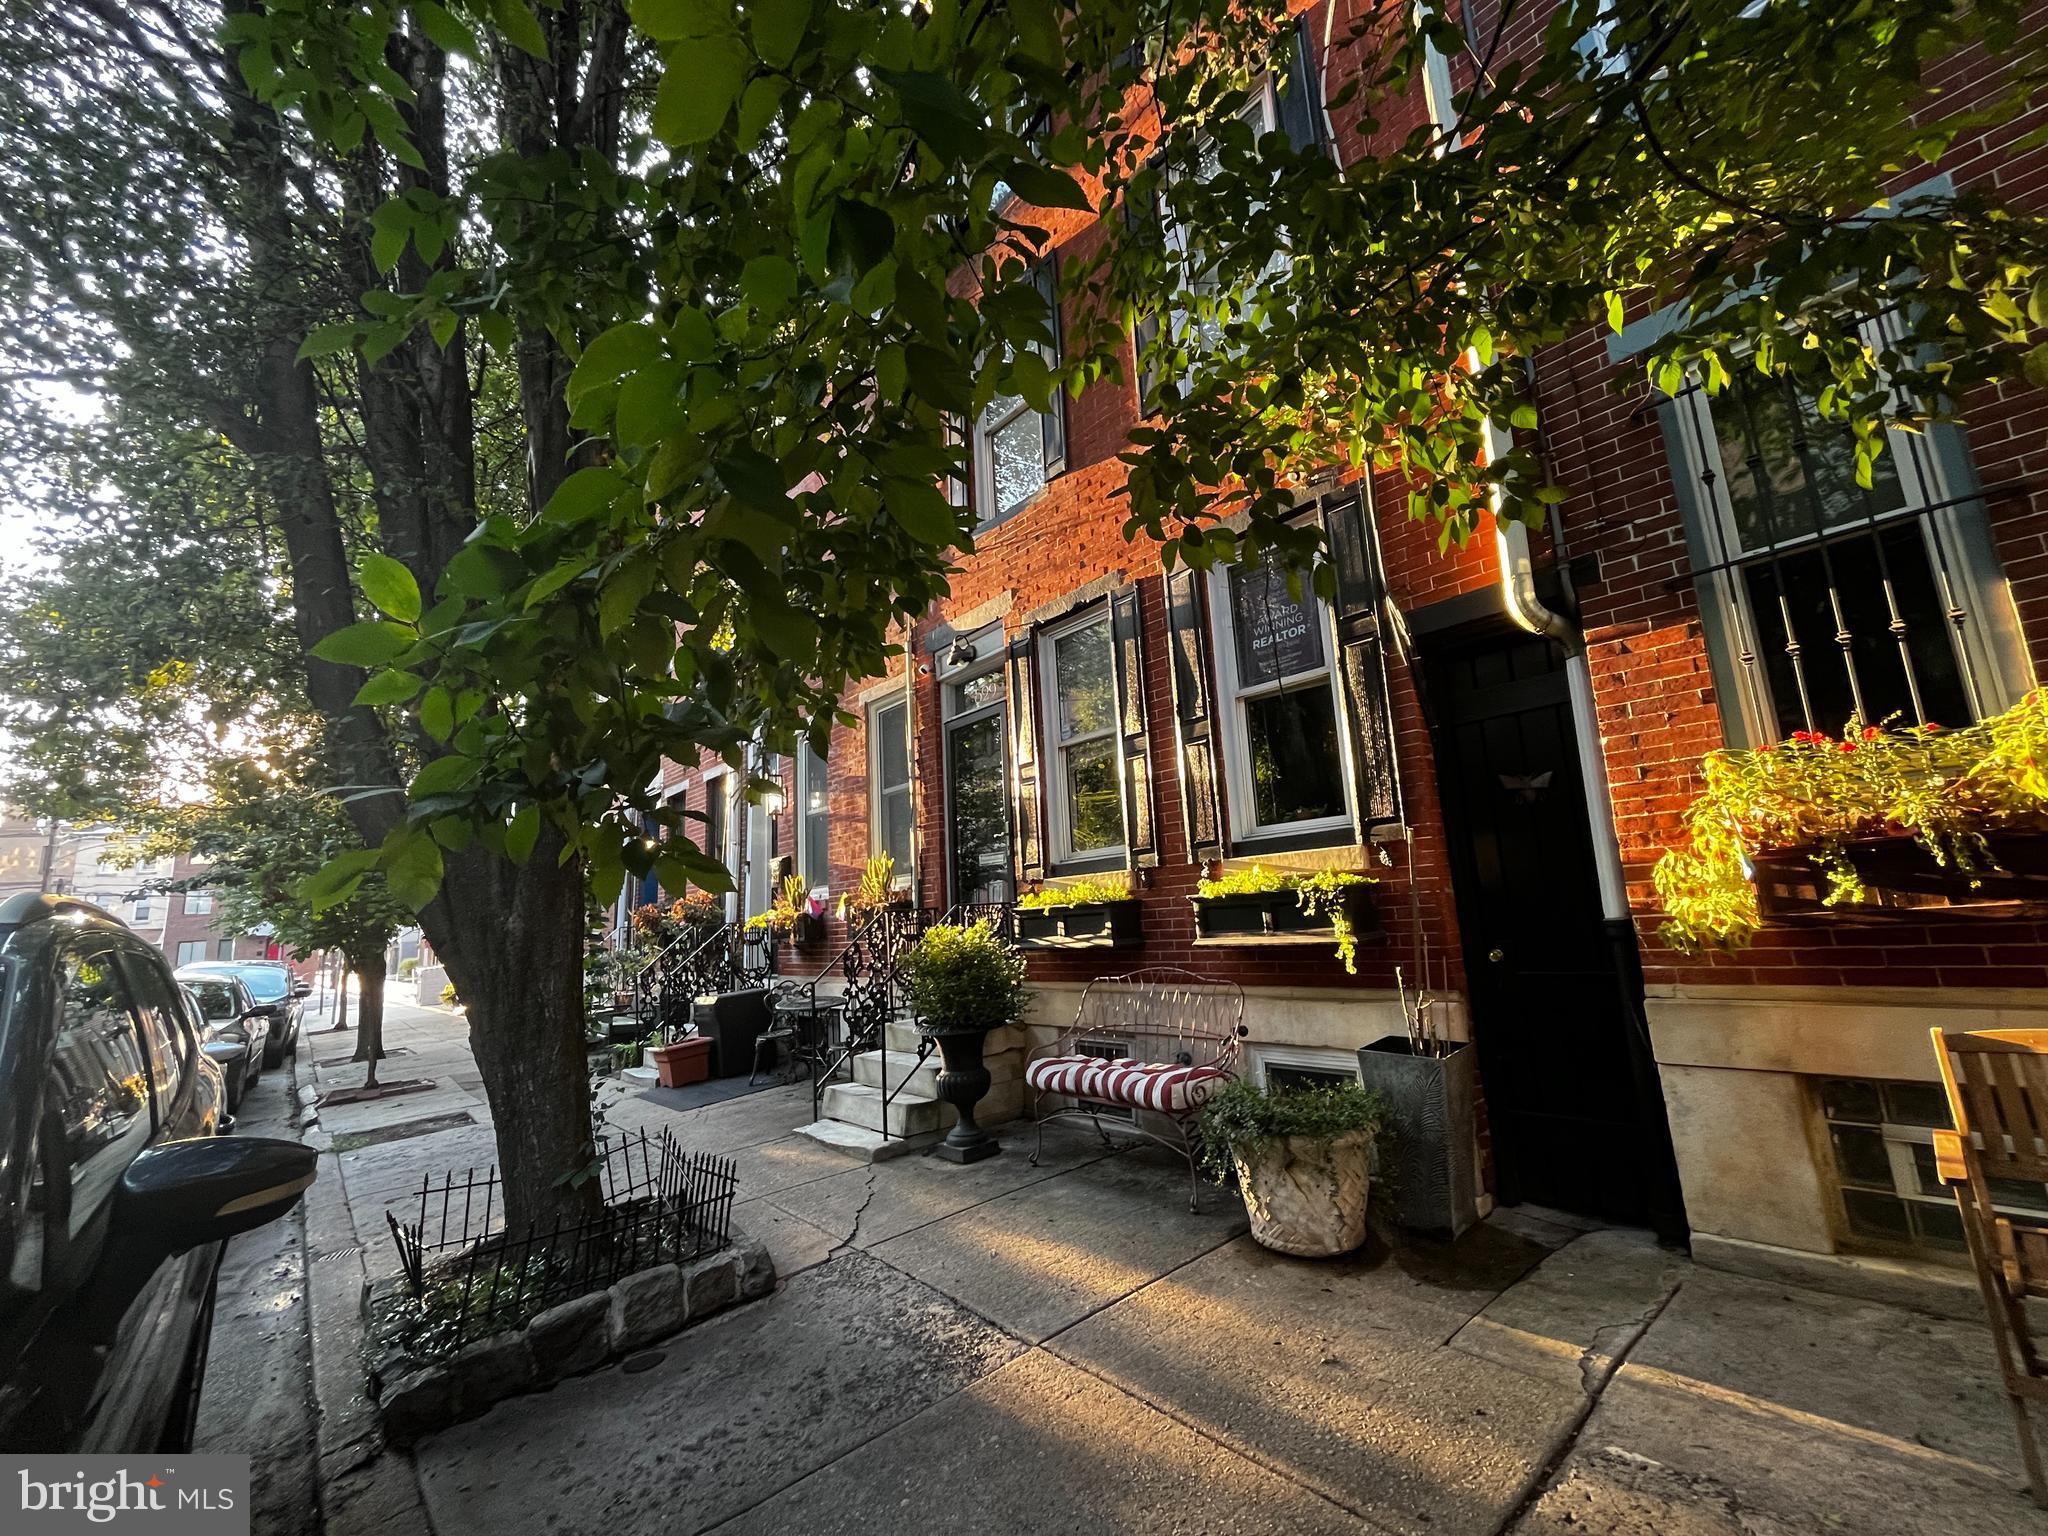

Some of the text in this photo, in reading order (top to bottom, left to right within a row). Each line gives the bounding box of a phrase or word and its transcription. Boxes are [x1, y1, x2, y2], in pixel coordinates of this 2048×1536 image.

[1253, 612, 1304, 637] WINNING
[1257, 603, 1299, 625] AWARD
[1252, 624, 1307, 650] REALTOR
